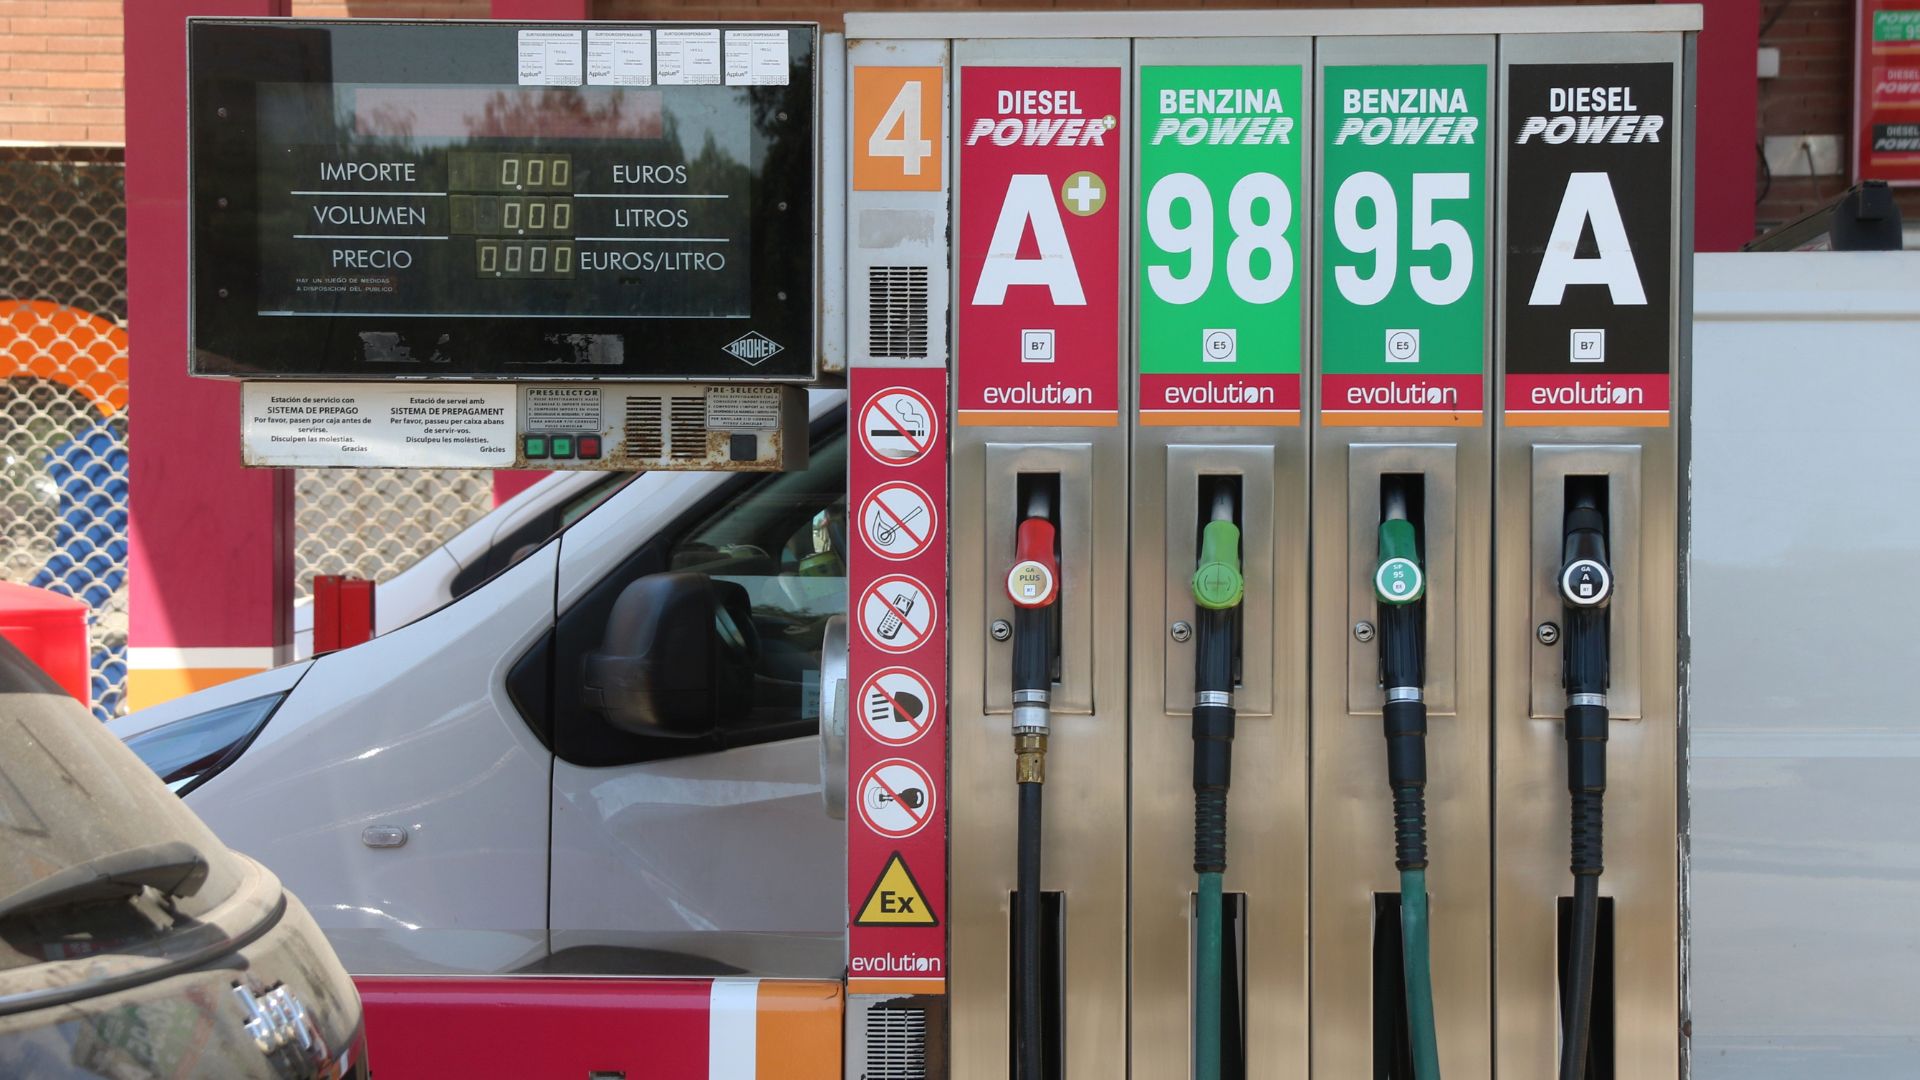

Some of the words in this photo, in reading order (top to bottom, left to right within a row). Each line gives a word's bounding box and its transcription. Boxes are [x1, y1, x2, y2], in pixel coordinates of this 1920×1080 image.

[997, 90, 1083, 115] DIESEL
[1159, 89, 1283, 114] BENZINA
[1343, 88, 1468, 114] BENZINA
[1550, 87, 1637, 112] DIESEL
[867, 80, 932, 176] 4
[1149, 117, 1294, 146] POWER
[1332, 116, 1479, 145] POWER
[1514, 115, 1664, 144] POWER
[320, 162, 416, 182] IMPORTE
[501, 159, 568, 190] 0.00
[612, 164, 687, 184] EUROS
[313, 205, 426, 225] VOLUMEN
[503, 202, 570, 234] 0.00
[615, 208, 689, 228] LITROS
[1146, 171, 1294, 305] 98
[1334, 171, 1474, 306] 95
[1527, 172, 1648, 306] A
[332, 250, 412, 269] PRECIO
[480, 246, 571, 277] 0.000
[580, 251, 726, 272] EUROS/LITRO
[1031, 341, 1045, 351] B7
[1212, 341, 1227, 350] E5
[1396, 341, 1410, 351] E5
[1580, 341, 1594, 350] B7
[983, 380, 1093, 405] evolution
[1165, 380, 1274, 404] evolution
[1347, 381, 1457, 405] evolution
[1531, 381, 1643, 405] evolution
[267, 406, 304, 414] SISTEMA
[306, 406, 317, 414] DE
[319, 406, 359, 414] PREPAGO
[326, 417, 340, 425] caja
[390, 407, 427, 415] SISTEMA
[428, 407, 440, 415] DE
[442, 407, 504, 415] PREPAGAMENT
[271, 435, 306, 443] Disculpen
[406, 436, 441, 444] Disculpeu
[1393, 571, 1404, 579] 95
[1582, 573, 1590, 581] A
[880, 891, 915, 914] Ex
[852, 952, 941, 973] evolution
